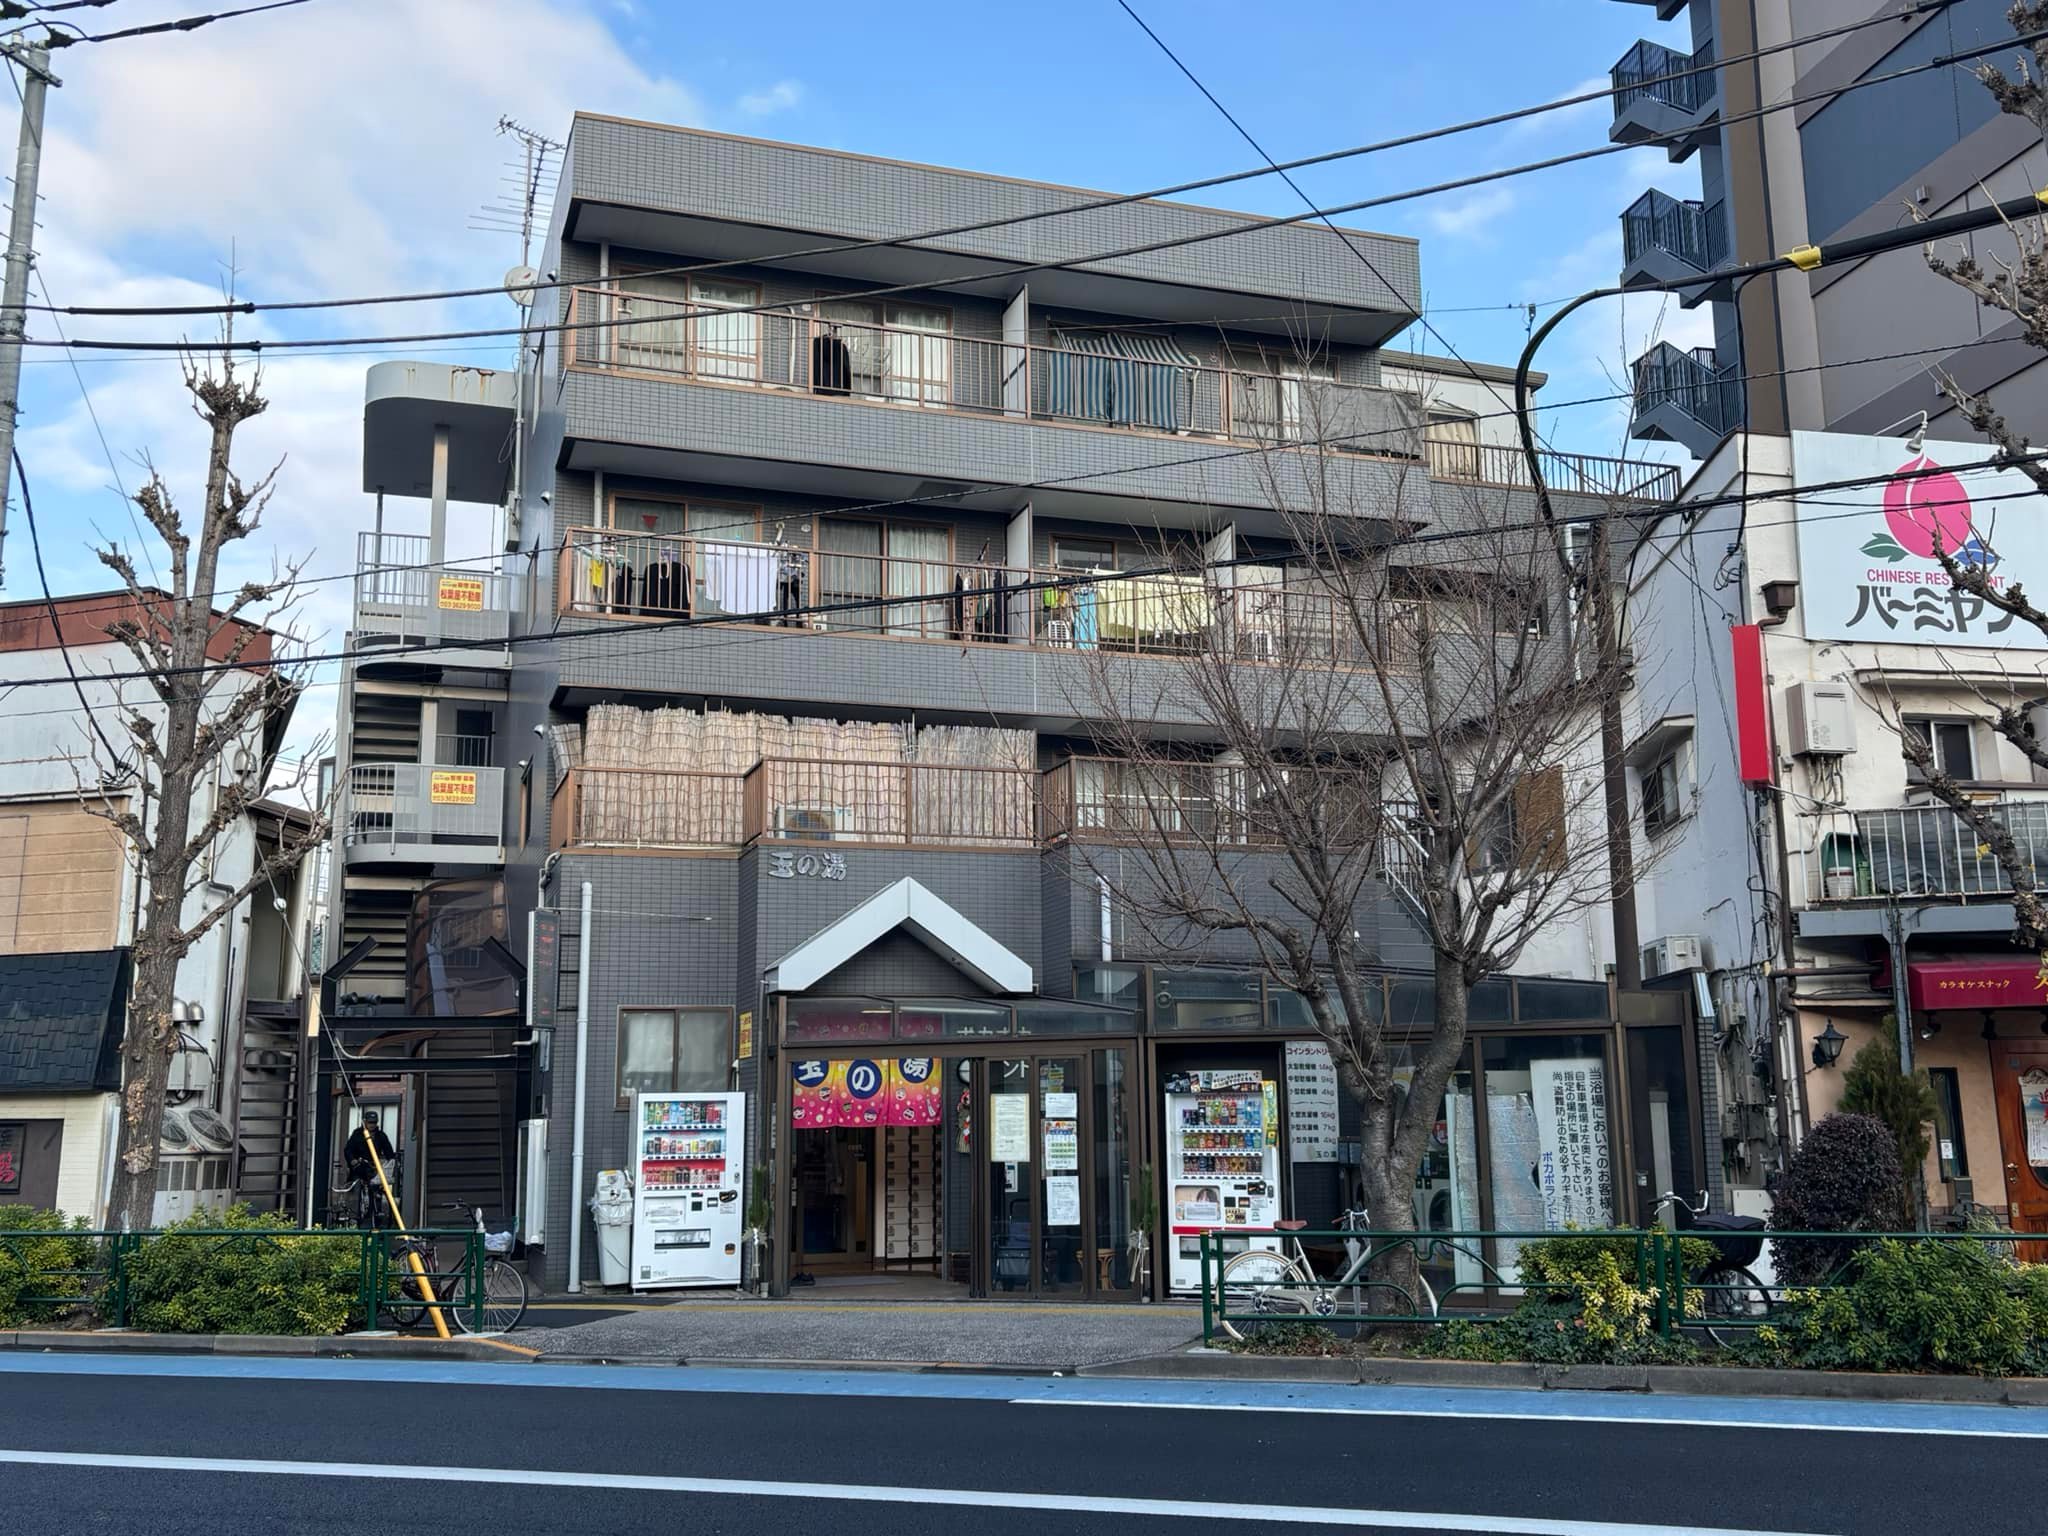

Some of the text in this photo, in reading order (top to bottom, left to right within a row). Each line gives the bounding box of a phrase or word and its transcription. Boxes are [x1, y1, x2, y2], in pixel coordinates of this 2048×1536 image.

[1867, 569, 2005, 588] CHINESE RESNT
[768, 852, 848, 881] 玉の湯
[1938, 978, 2011, 990] カラオケスナック
[1287, 1047, 1329, 1055] コインランドリ
[797, 1057, 930, 1092] 玉の湯
